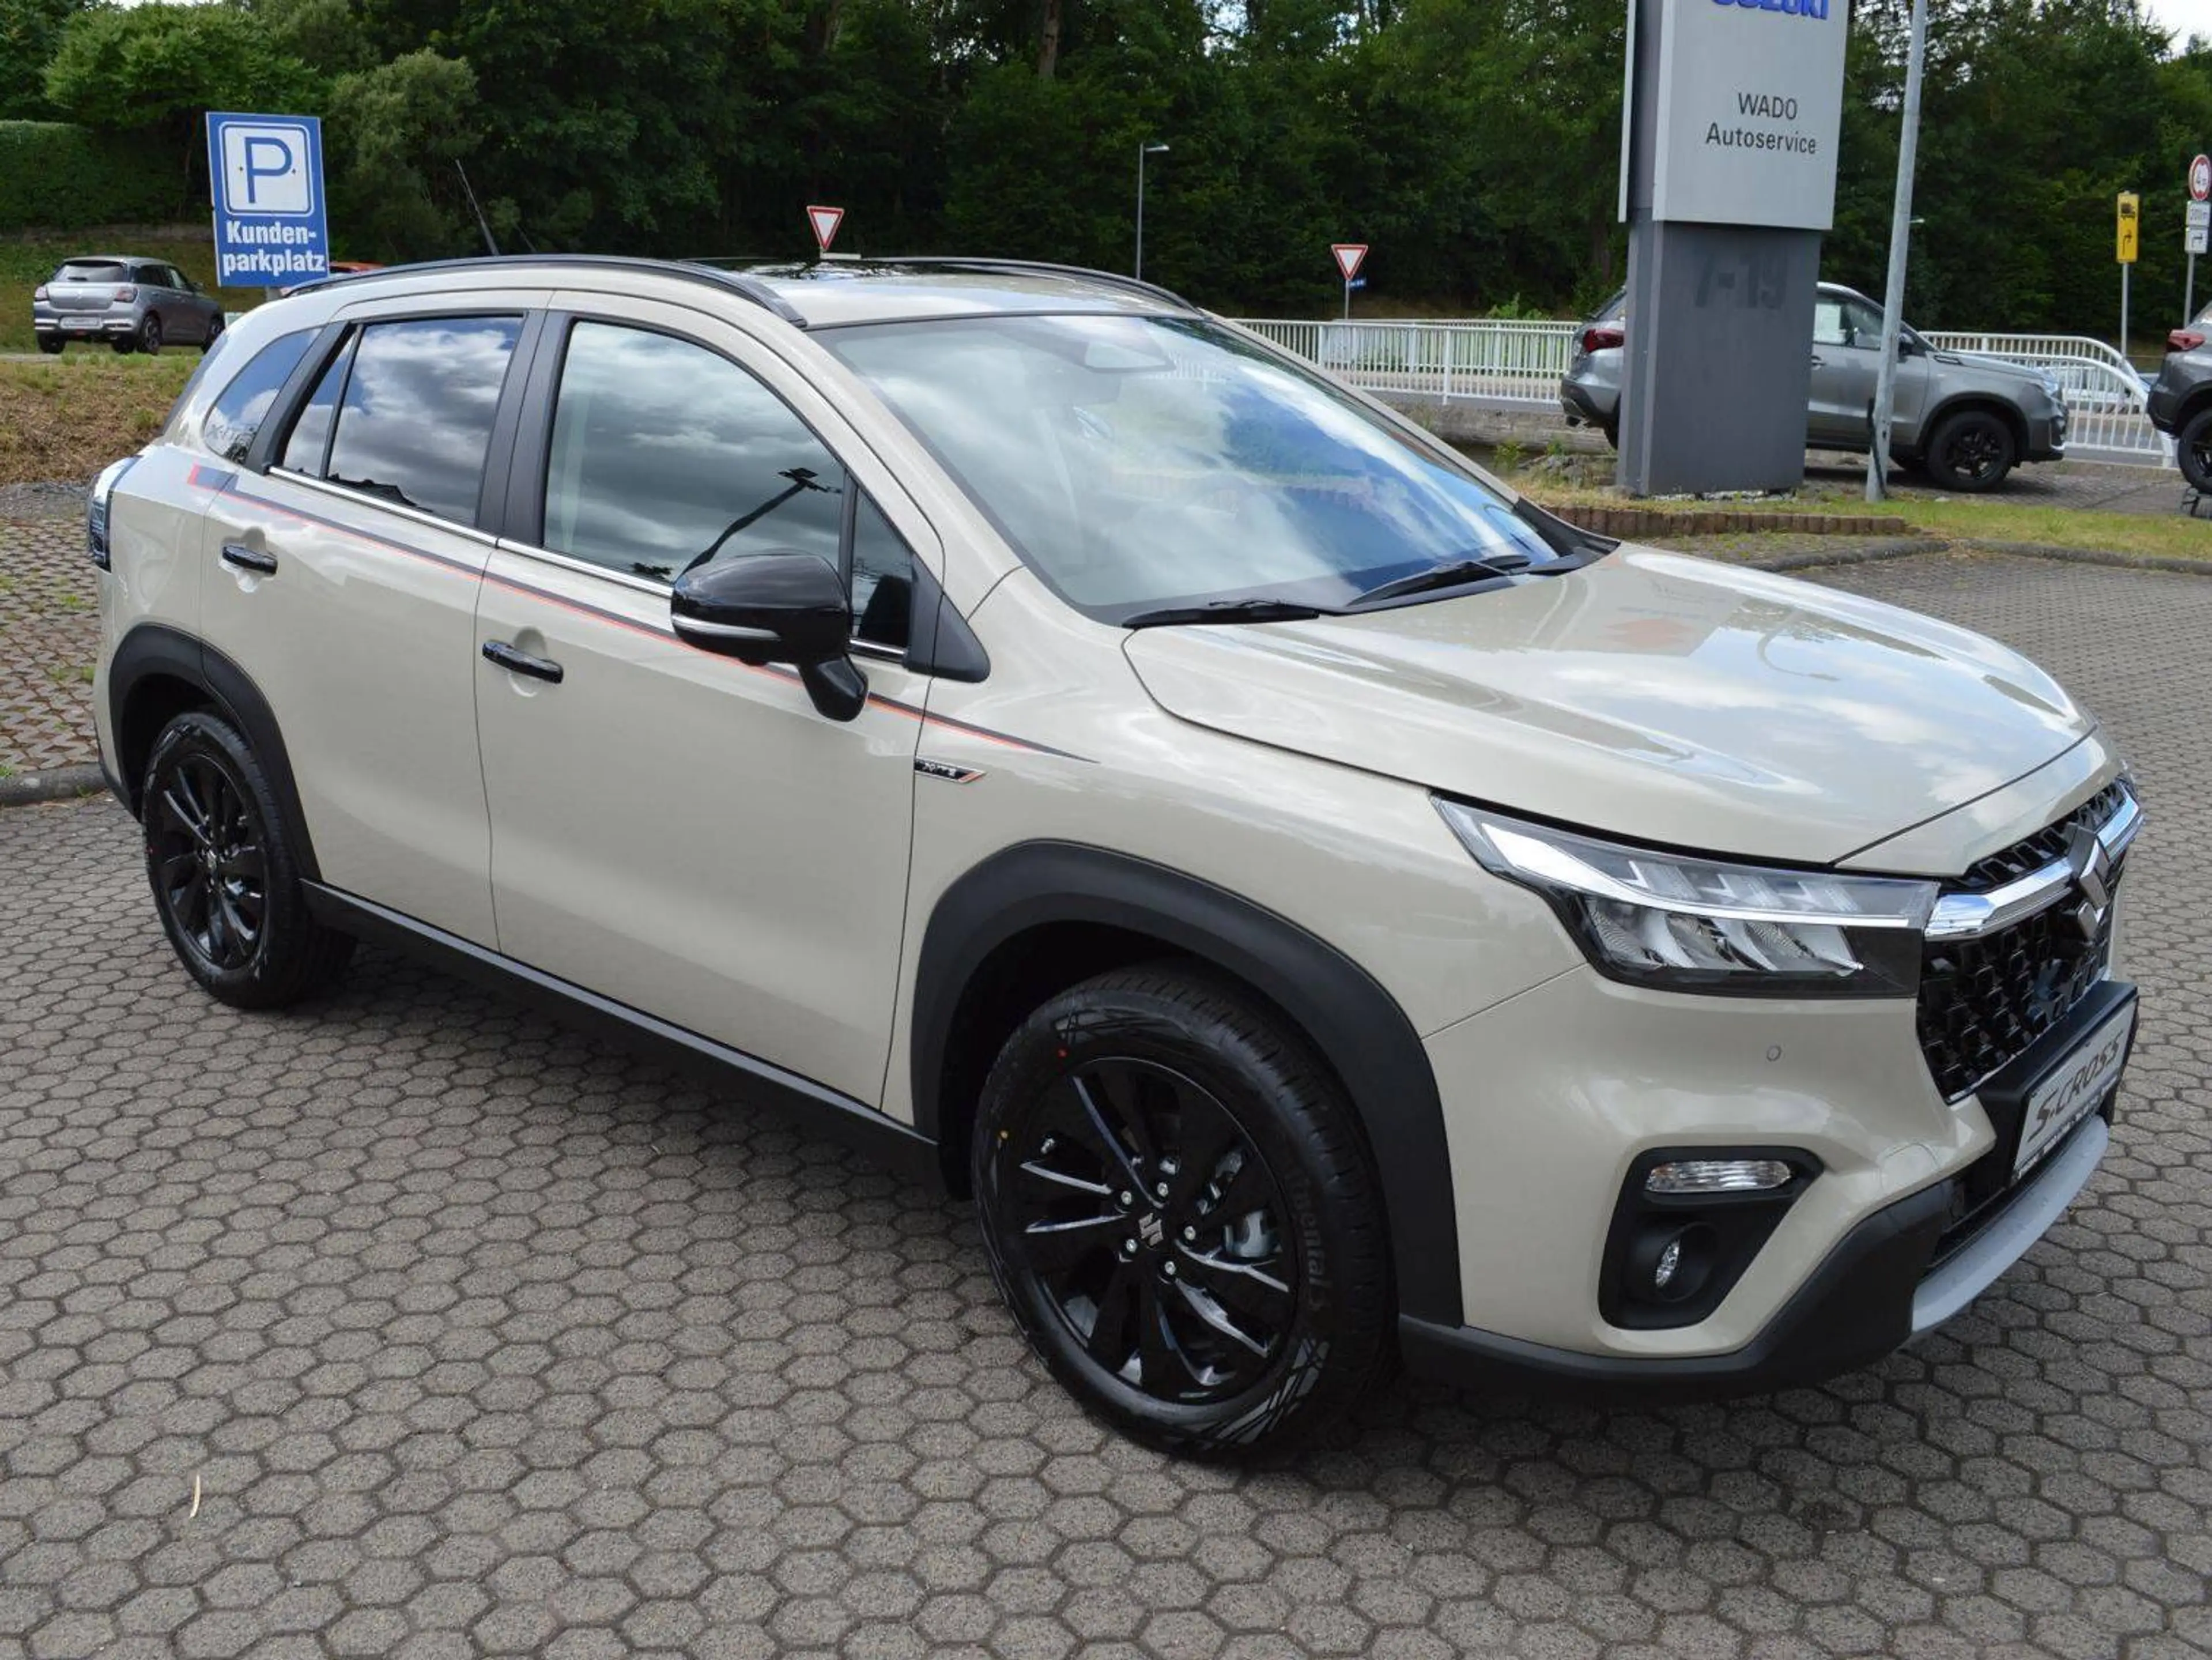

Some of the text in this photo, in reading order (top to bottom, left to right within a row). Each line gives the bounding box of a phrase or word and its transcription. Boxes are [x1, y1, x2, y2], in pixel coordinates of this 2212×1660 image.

[1738, 92, 1798, 120] WADO
[1705, 122, 1816, 154] Autoservice
[244, 137, 292, 203] P
[226, 220, 317, 245] Kunden-
[222, 248, 326, 277] parkplatz
